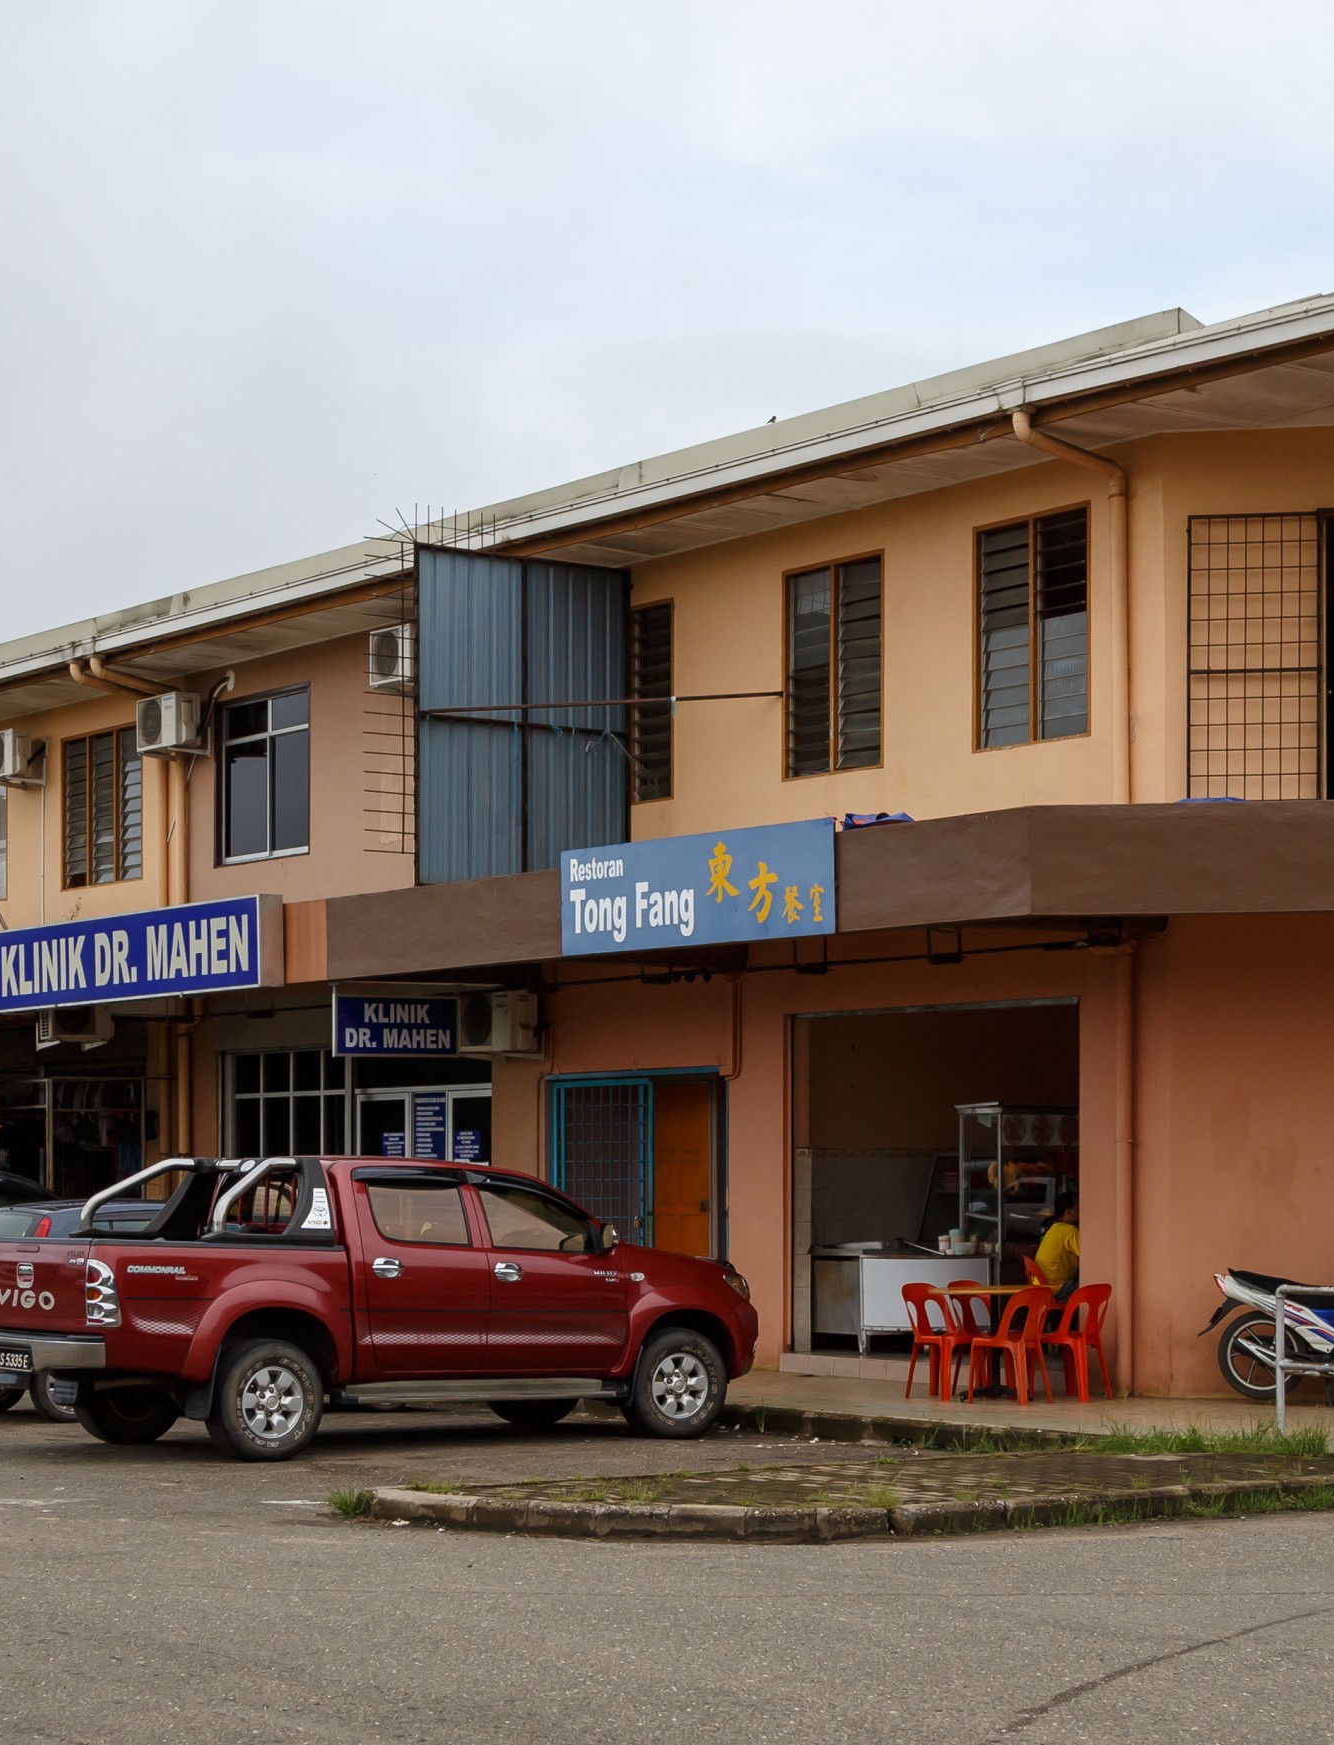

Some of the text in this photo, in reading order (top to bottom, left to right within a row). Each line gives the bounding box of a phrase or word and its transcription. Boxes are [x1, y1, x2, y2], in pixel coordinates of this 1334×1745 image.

[569, 856, 624, 882] Restoran
[705, 841, 825, 924] 東方餐室
[569, 881, 695, 943] Tong Fang
[1, 914, 249, 998] KLINIK DR. MAHEN
[364, 1003, 430, 1024] KLINIK
[345, 1027, 451, 1049] DR. MAHEN
[126, 1264, 187, 1275] COMMONRAIL
[5, 1353, 23, 1368] 5335
